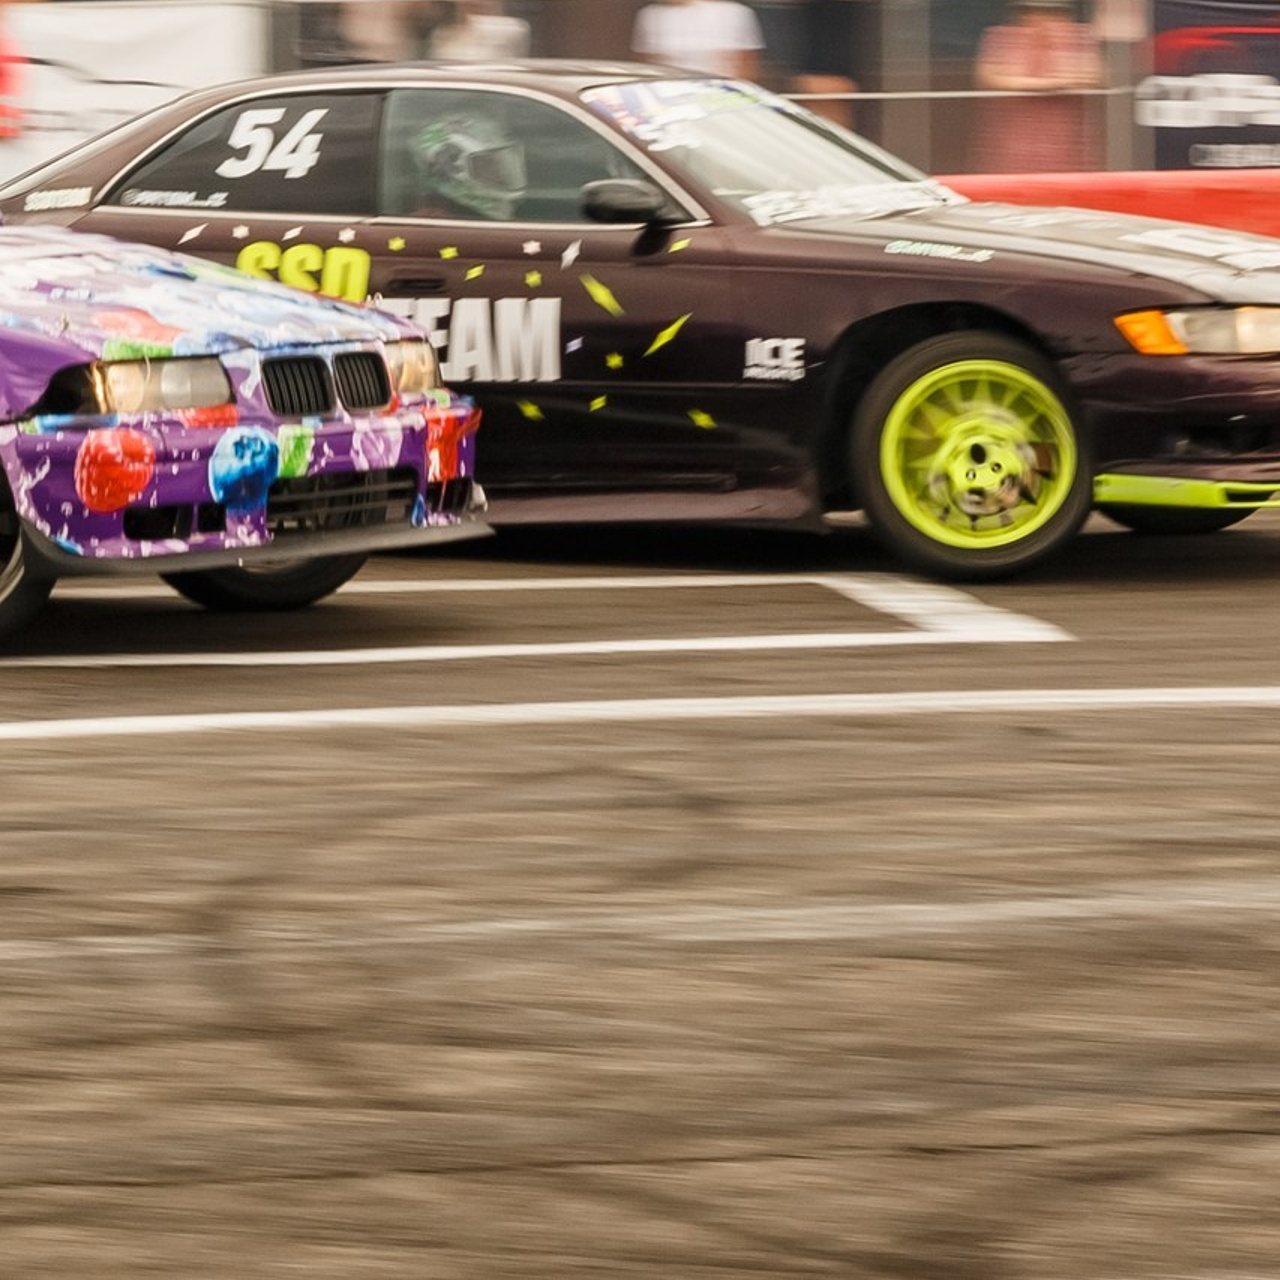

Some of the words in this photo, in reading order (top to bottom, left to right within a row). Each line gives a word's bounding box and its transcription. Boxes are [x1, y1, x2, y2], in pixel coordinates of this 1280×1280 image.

[216, 107, 329, 179] 54
[380, 297, 562, 382] EAM
[745, 337, 806, 368] ICE
